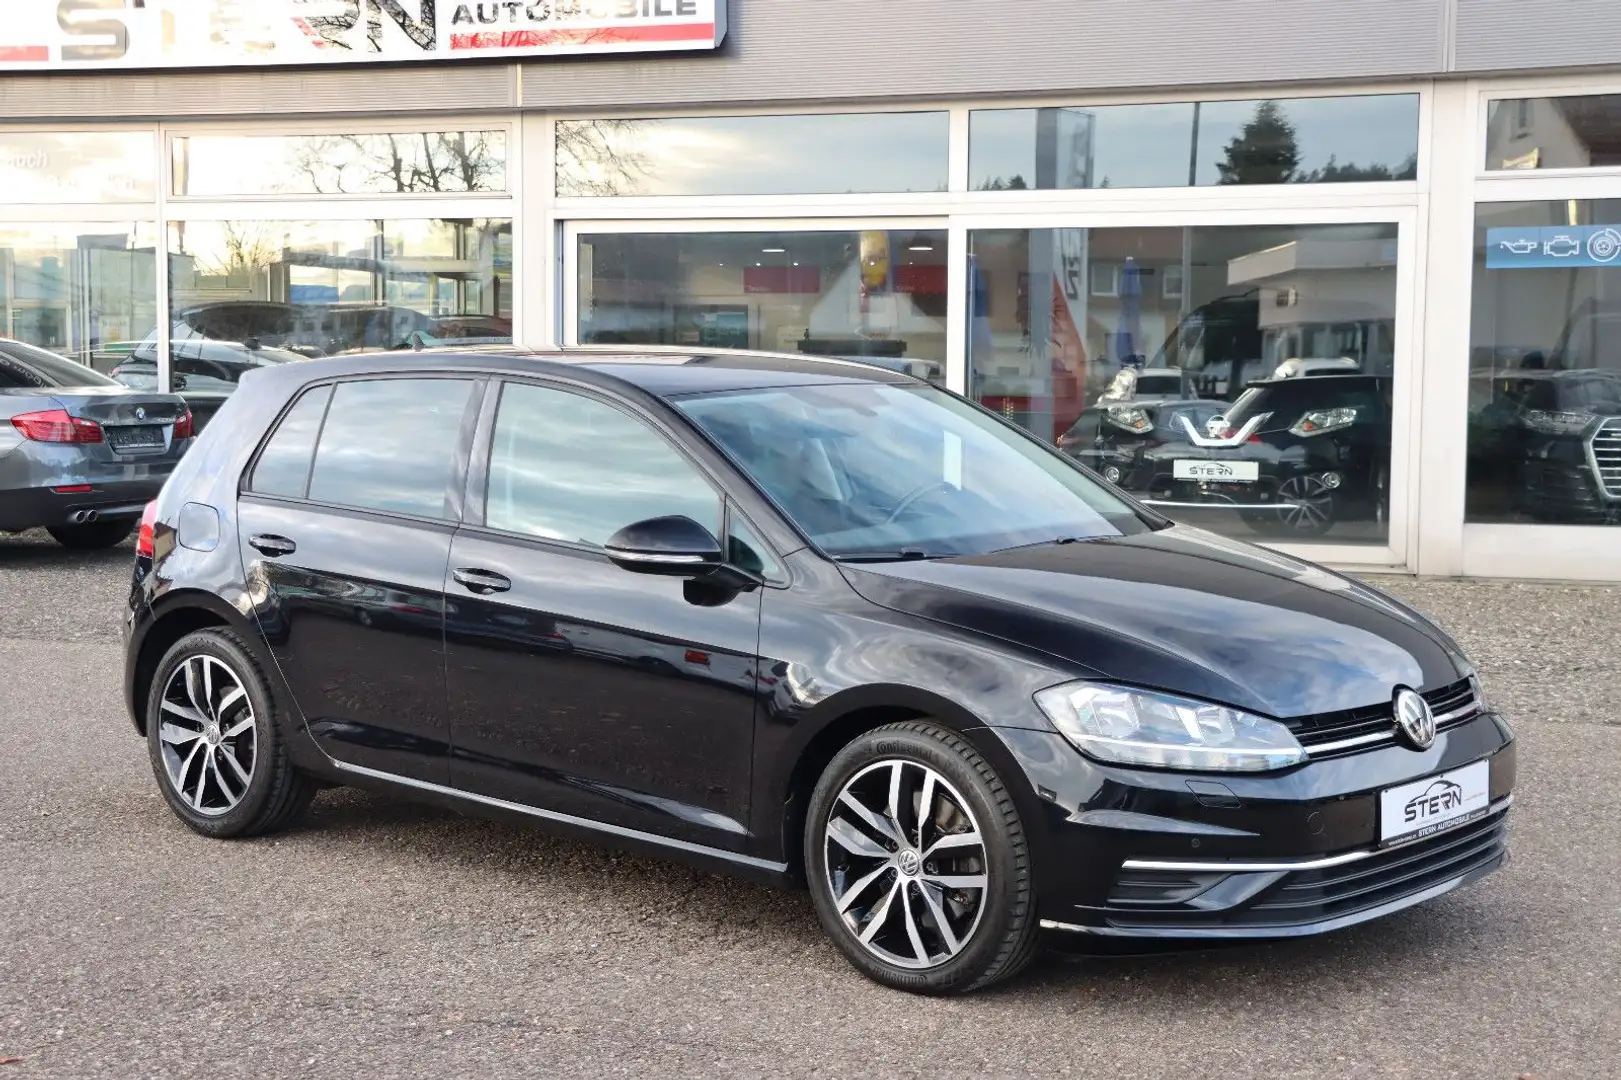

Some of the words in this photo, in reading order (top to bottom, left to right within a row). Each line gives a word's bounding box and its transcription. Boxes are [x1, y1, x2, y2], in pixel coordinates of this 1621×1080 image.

[1189, 466, 1233, 476] STERN
[1404, 789, 1462, 822] STERN
[1418, 824, 1437, 837] STERN
[1438, 813, 1470, 831] AUTOMOBILE
